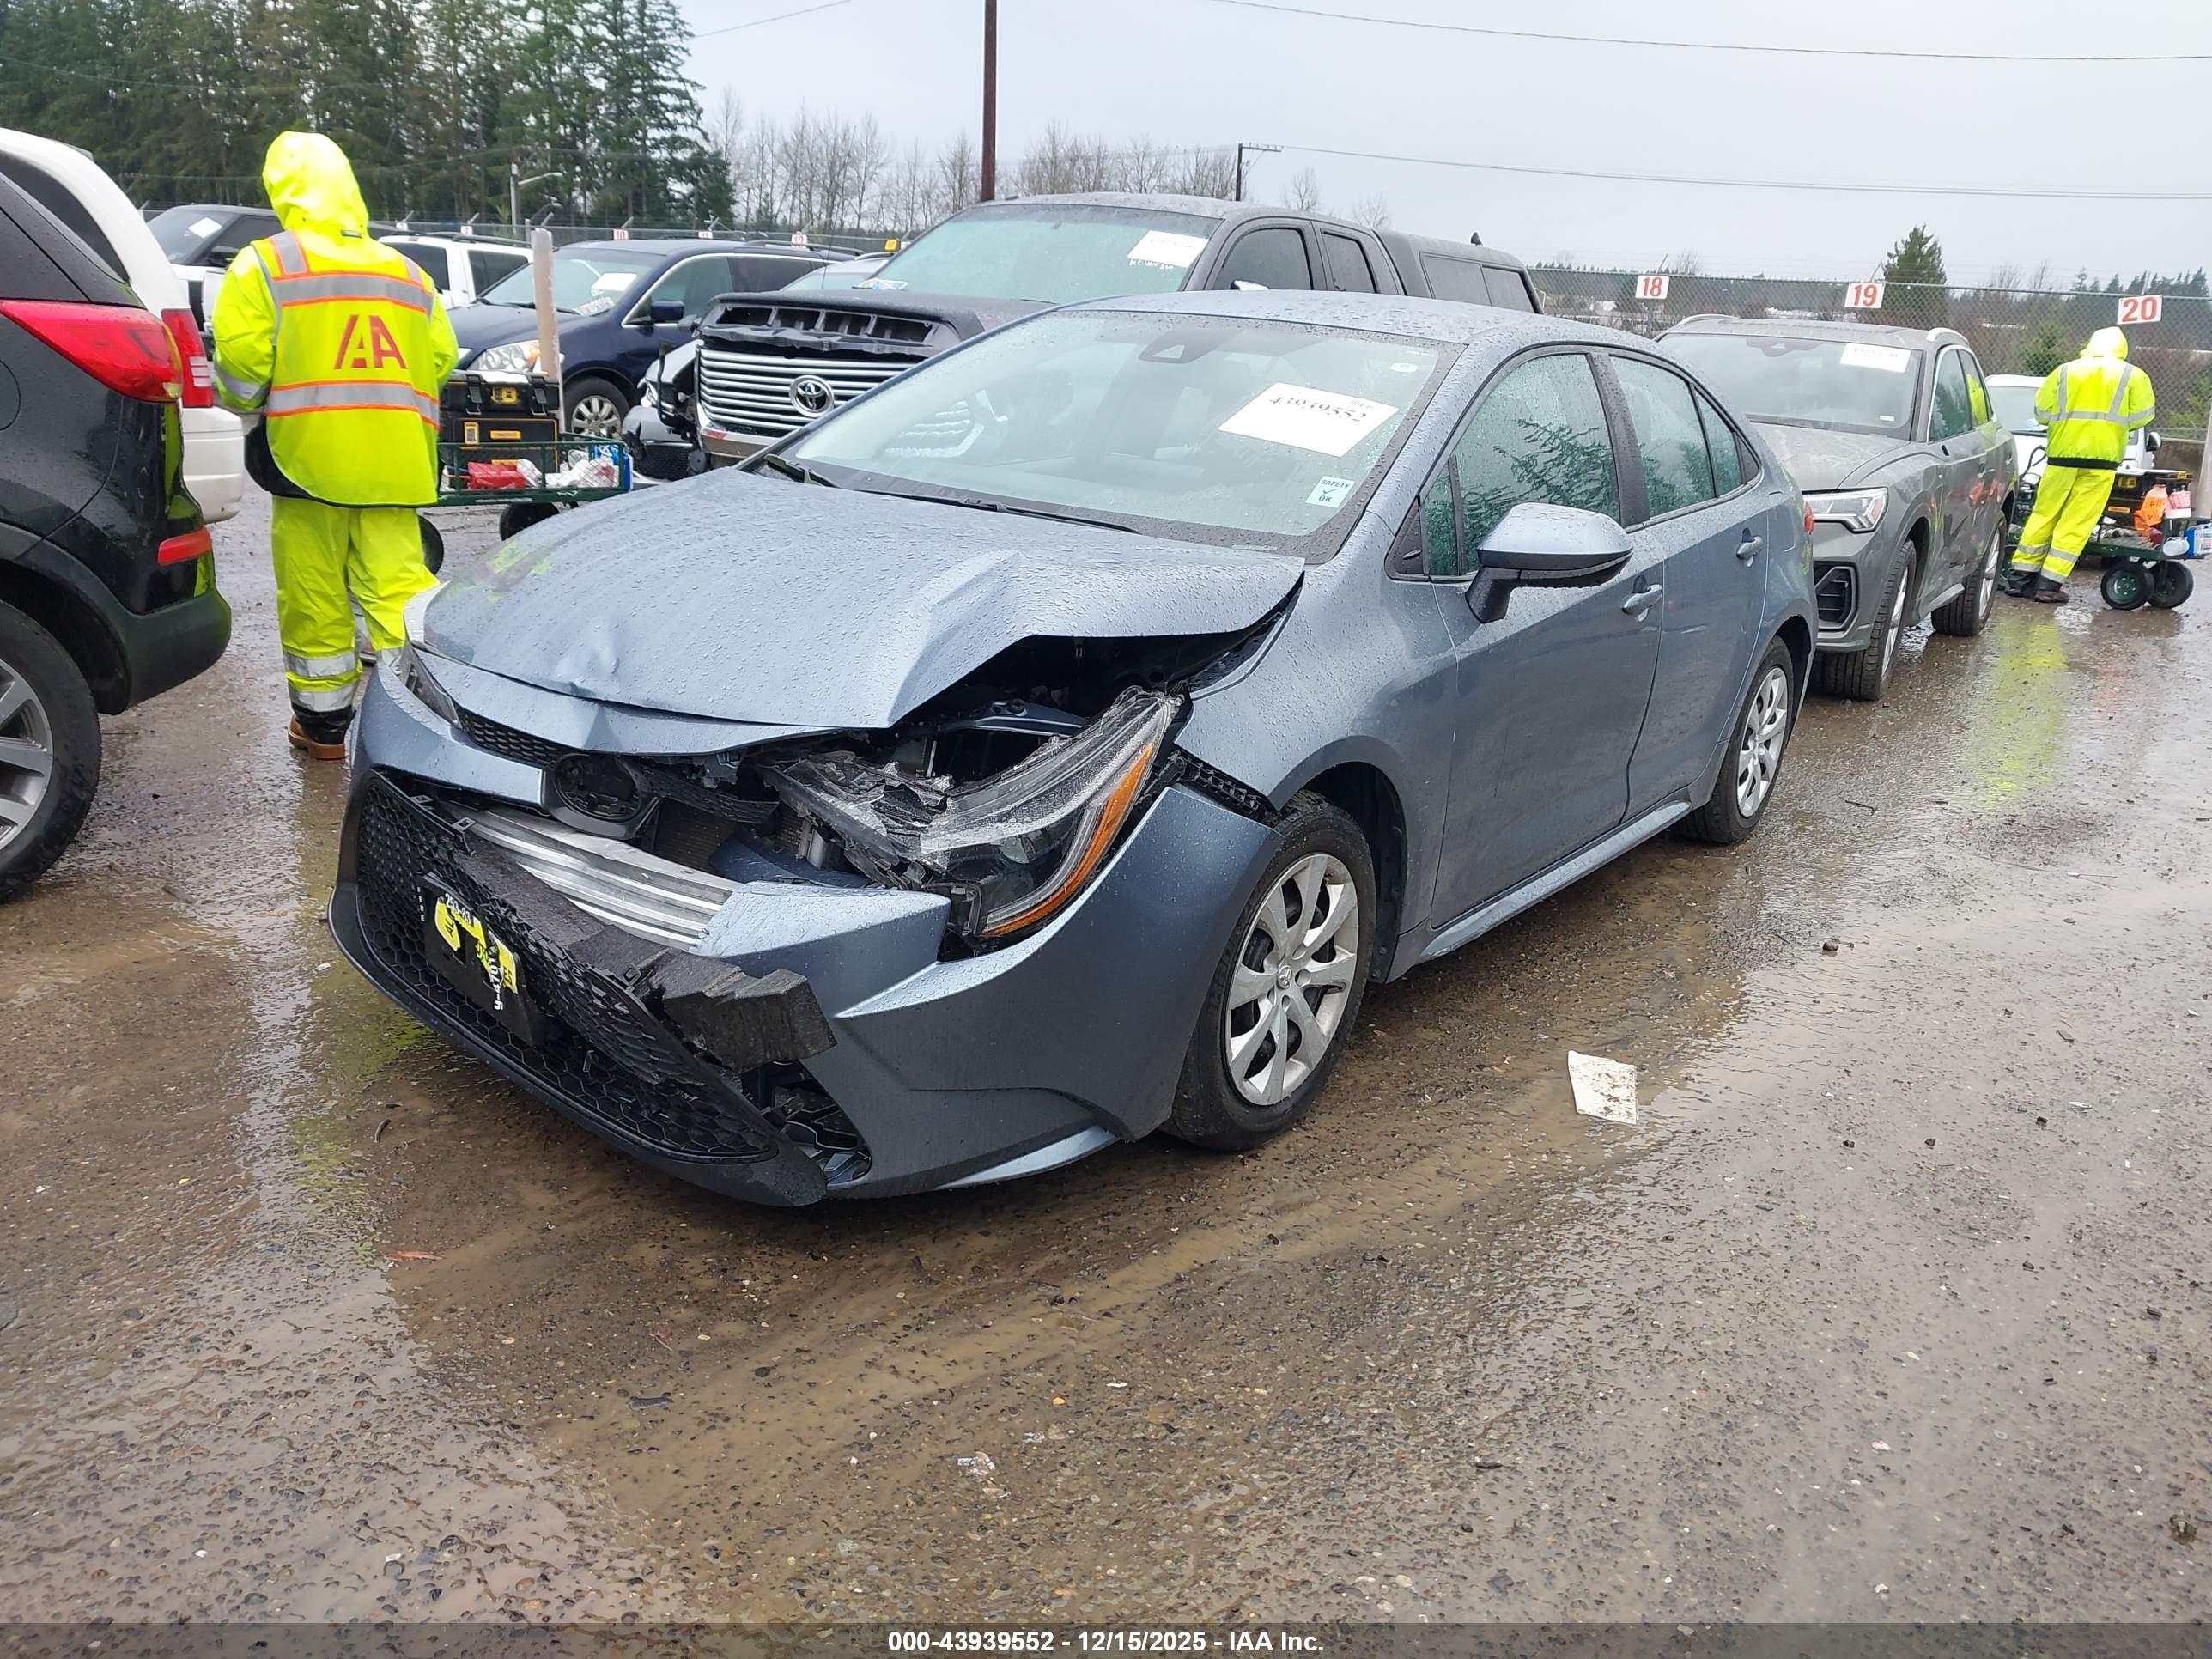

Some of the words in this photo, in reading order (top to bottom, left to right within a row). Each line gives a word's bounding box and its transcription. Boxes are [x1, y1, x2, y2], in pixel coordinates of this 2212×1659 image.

[1643, 276, 1663, 297] 18
[1853, 284, 1878, 307] 19
[2122, 296, 2158, 322] 20
[1320, 479, 1351, 489] SAFETY
